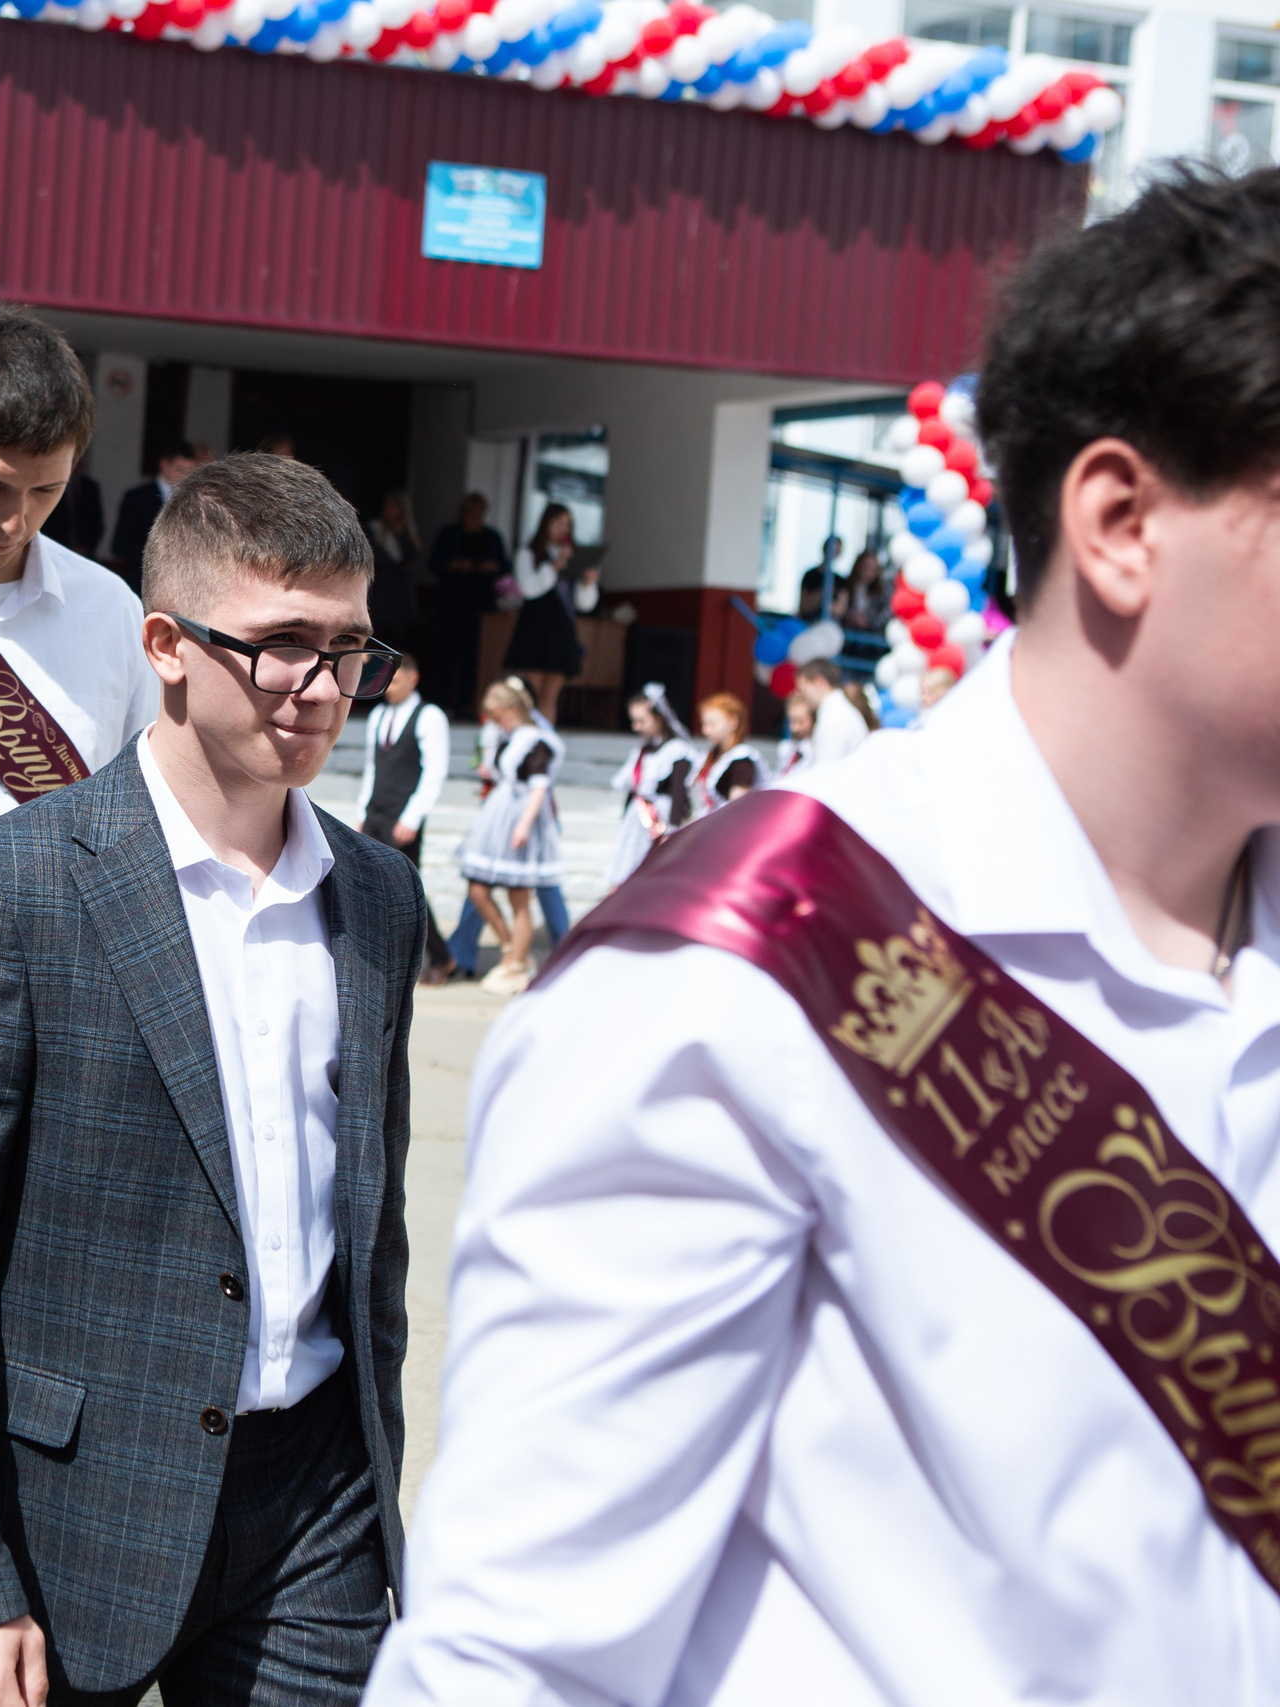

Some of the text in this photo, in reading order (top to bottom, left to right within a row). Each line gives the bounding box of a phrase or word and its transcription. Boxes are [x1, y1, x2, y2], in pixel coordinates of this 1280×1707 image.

[52, 743, 83, 782] Листо
[916, 996, 1054, 1159] 11«А»
[983, 1060, 1090, 1197] класс
